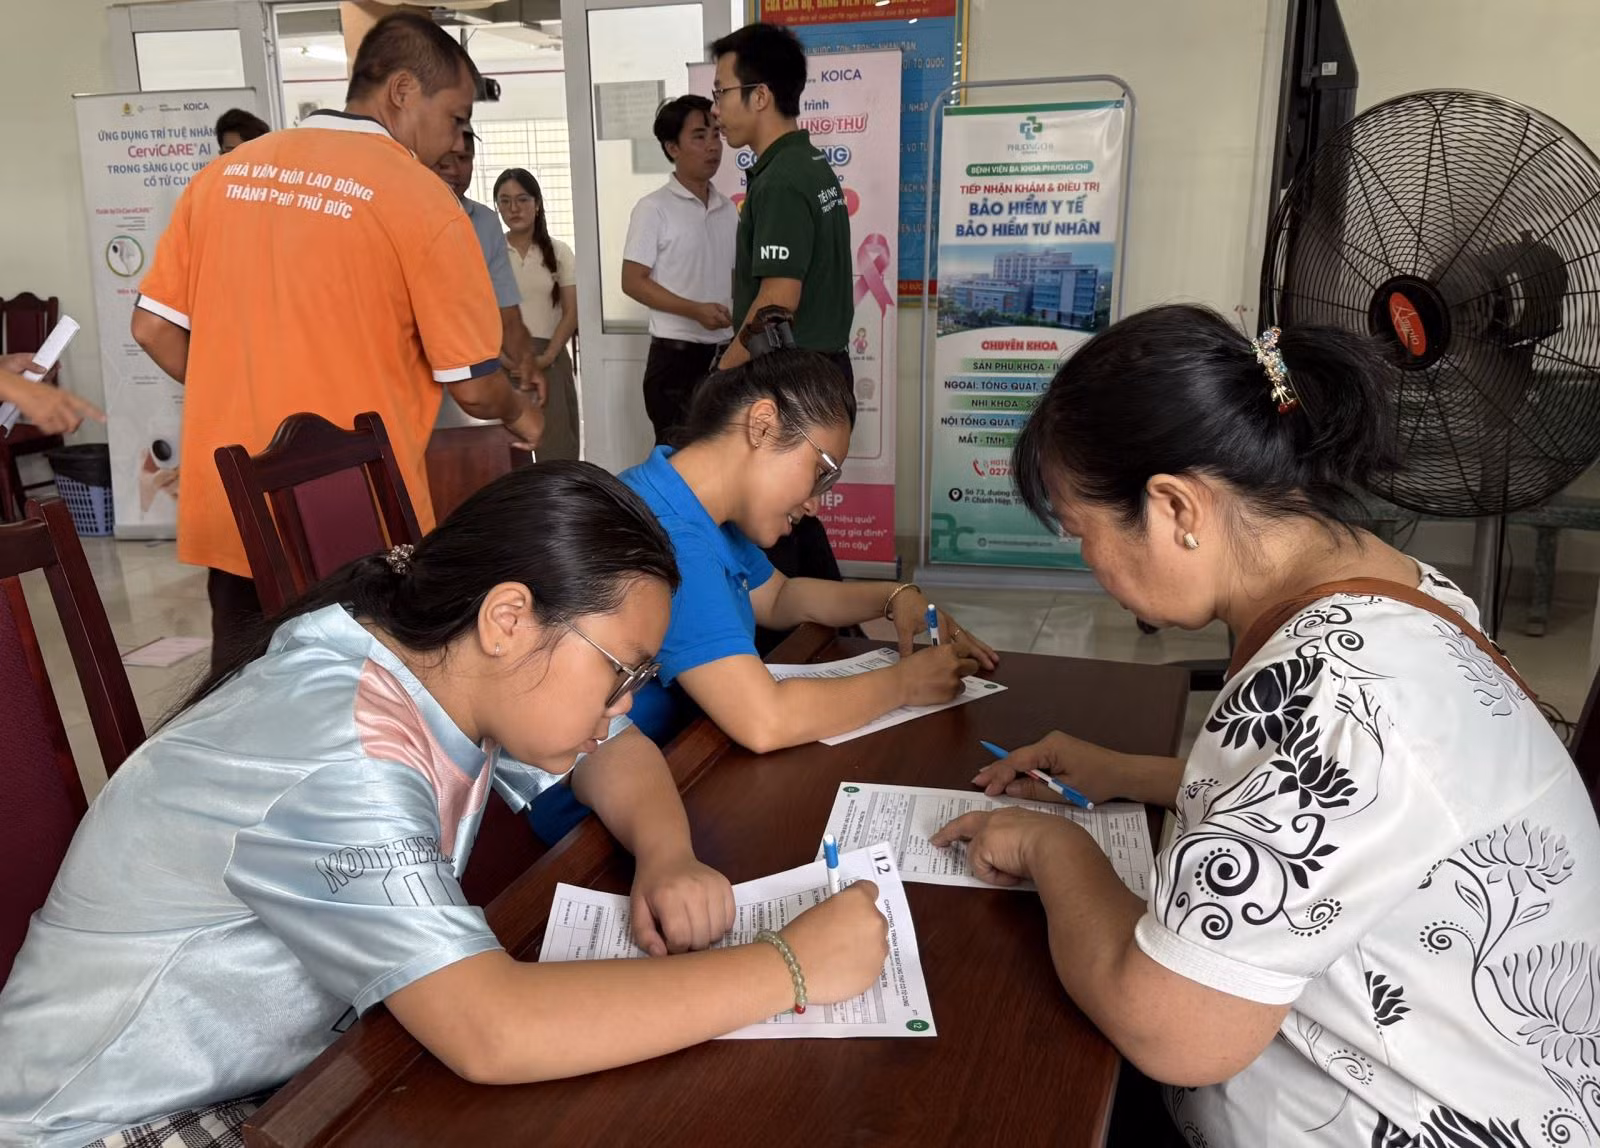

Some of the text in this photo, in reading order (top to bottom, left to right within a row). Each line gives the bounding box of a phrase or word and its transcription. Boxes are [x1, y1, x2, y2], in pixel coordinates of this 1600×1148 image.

[821, 69, 862, 82] KOICA
[183, 102, 210, 111] KOICA
[804, 99, 829, 111] trình
[836, 113, 868, 131] THƯ
[98, 129, 119, 142] ỨNG
[121, 128, 149, 143] DỤNG
[150, 127, 166, 139] TRÍ
[168, 126, 187, 140] TUỆ
[198, 143, 211, 156] AI
[107, 164, 140, 174] TRONG
[143, 161, 168, 173] SÀNG
[170, 162, 189, 174] LỌC
[251, 163, 278, 178] VĂN
[306, 172, 332, 189] LAO
[333, 177, 374, 202] ĐỘNG
[960, 181, 1100, 196] TIẾP NHẬN KHÁM & ĐIỀU TRỊ
[297, 192, 323, 211] THỦ
[323, 198, 353, 220] ĐỨC
[969, 194, 1087, 216] BẢO HIỂM Y TẾ
[956, 219, 987, 237] BẢO
[992, 215, 1028, 236] HIỂM
[1032, 220, 1052, 236] TƯ
[1055, 218, 1100, 235] NHÂN
[760, 245, 790, 260] NTD
[981, 338, 1058, 352] CHUYÊN KHOA
[973, 361, 992, 371] SẢN
[1017, 362, 1045, 371] KHOA
[971, 399, 987, 408] NHI
[991, 399, 1018, 408] KHOA
[941, 415, 958, 426] NỘI
[961, 414, 987, 426] TỔNG
[958, 434, 978, 445] MẮT
[986, 436, 1005, 445] TMH
[821, 490, 844, 510] IỆP
